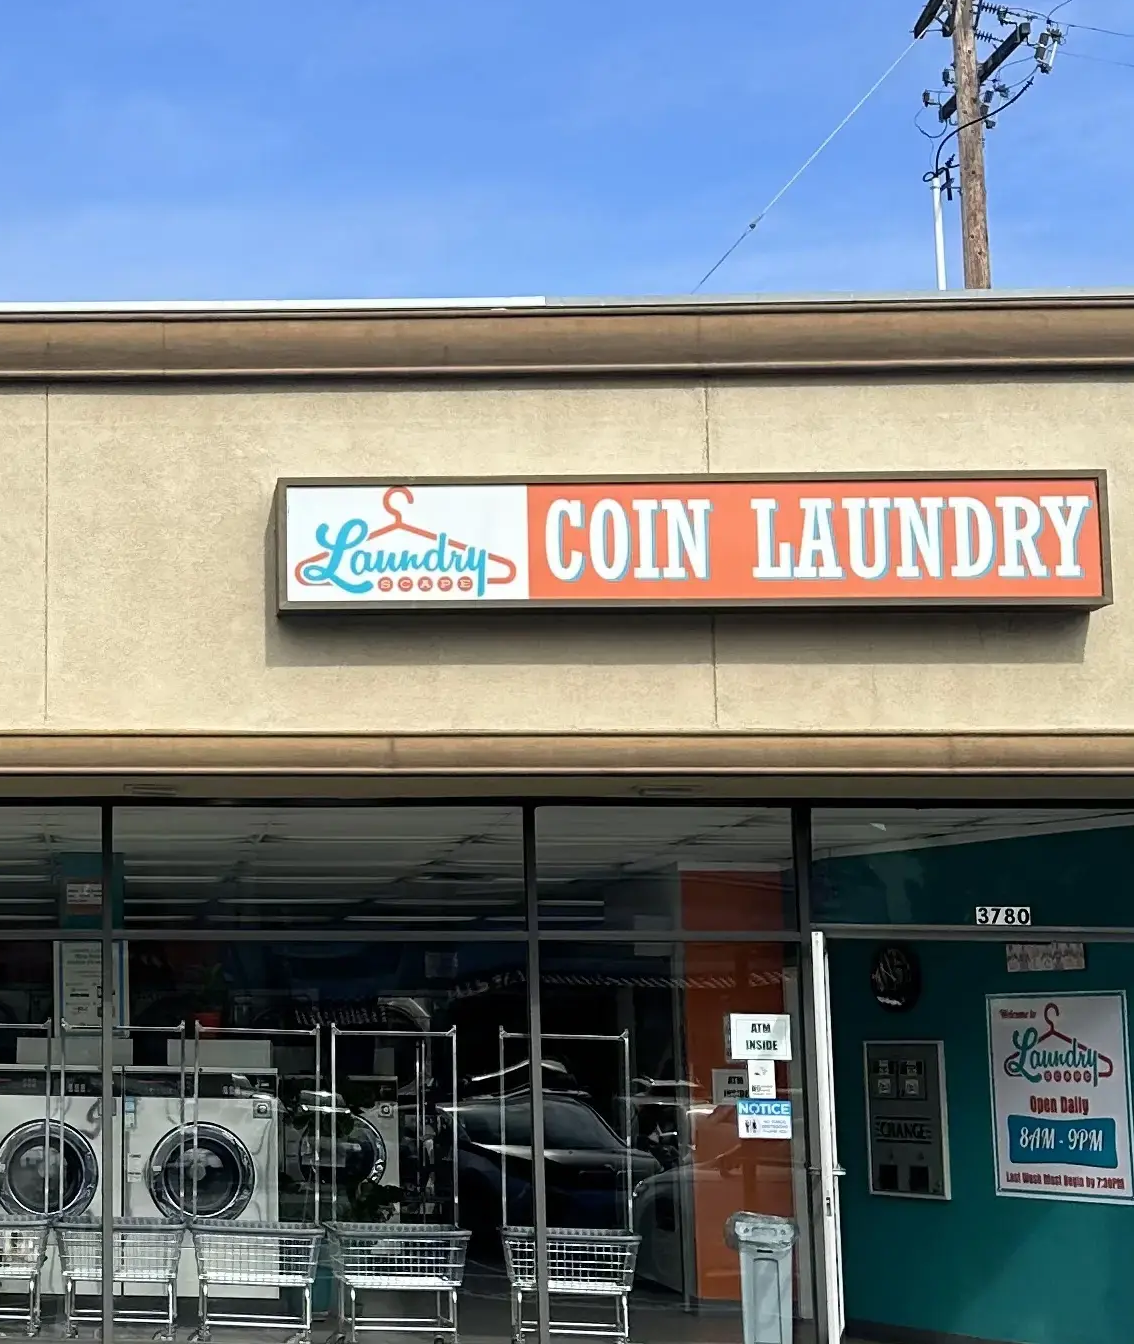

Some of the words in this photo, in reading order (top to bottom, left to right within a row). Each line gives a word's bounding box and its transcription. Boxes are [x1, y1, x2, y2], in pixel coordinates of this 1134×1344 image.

[544, 497, 713, 582] COIN
[750, 494, 1091, 580] LAUNDRY
[303, 518, 486, 597] Laundry
[377, 576, 474, 592] SCAPE
[977, 907, 1030, 925] 3780
[751, 1023, 771, 1033] ATM
[746, 1040, 778, 1050] INSIDE
[1008, 1027, 1098, 1087] Laundry
[738, 1103, 791, 1115] NOTICE
[1030, 1095, 1057, 1114] Open
[1060, 1096, 1089, 1115] Daily
[1019, 1127, 1056, 1151] 8AM
[1067, 1128, 1103, 1152] 9PM
